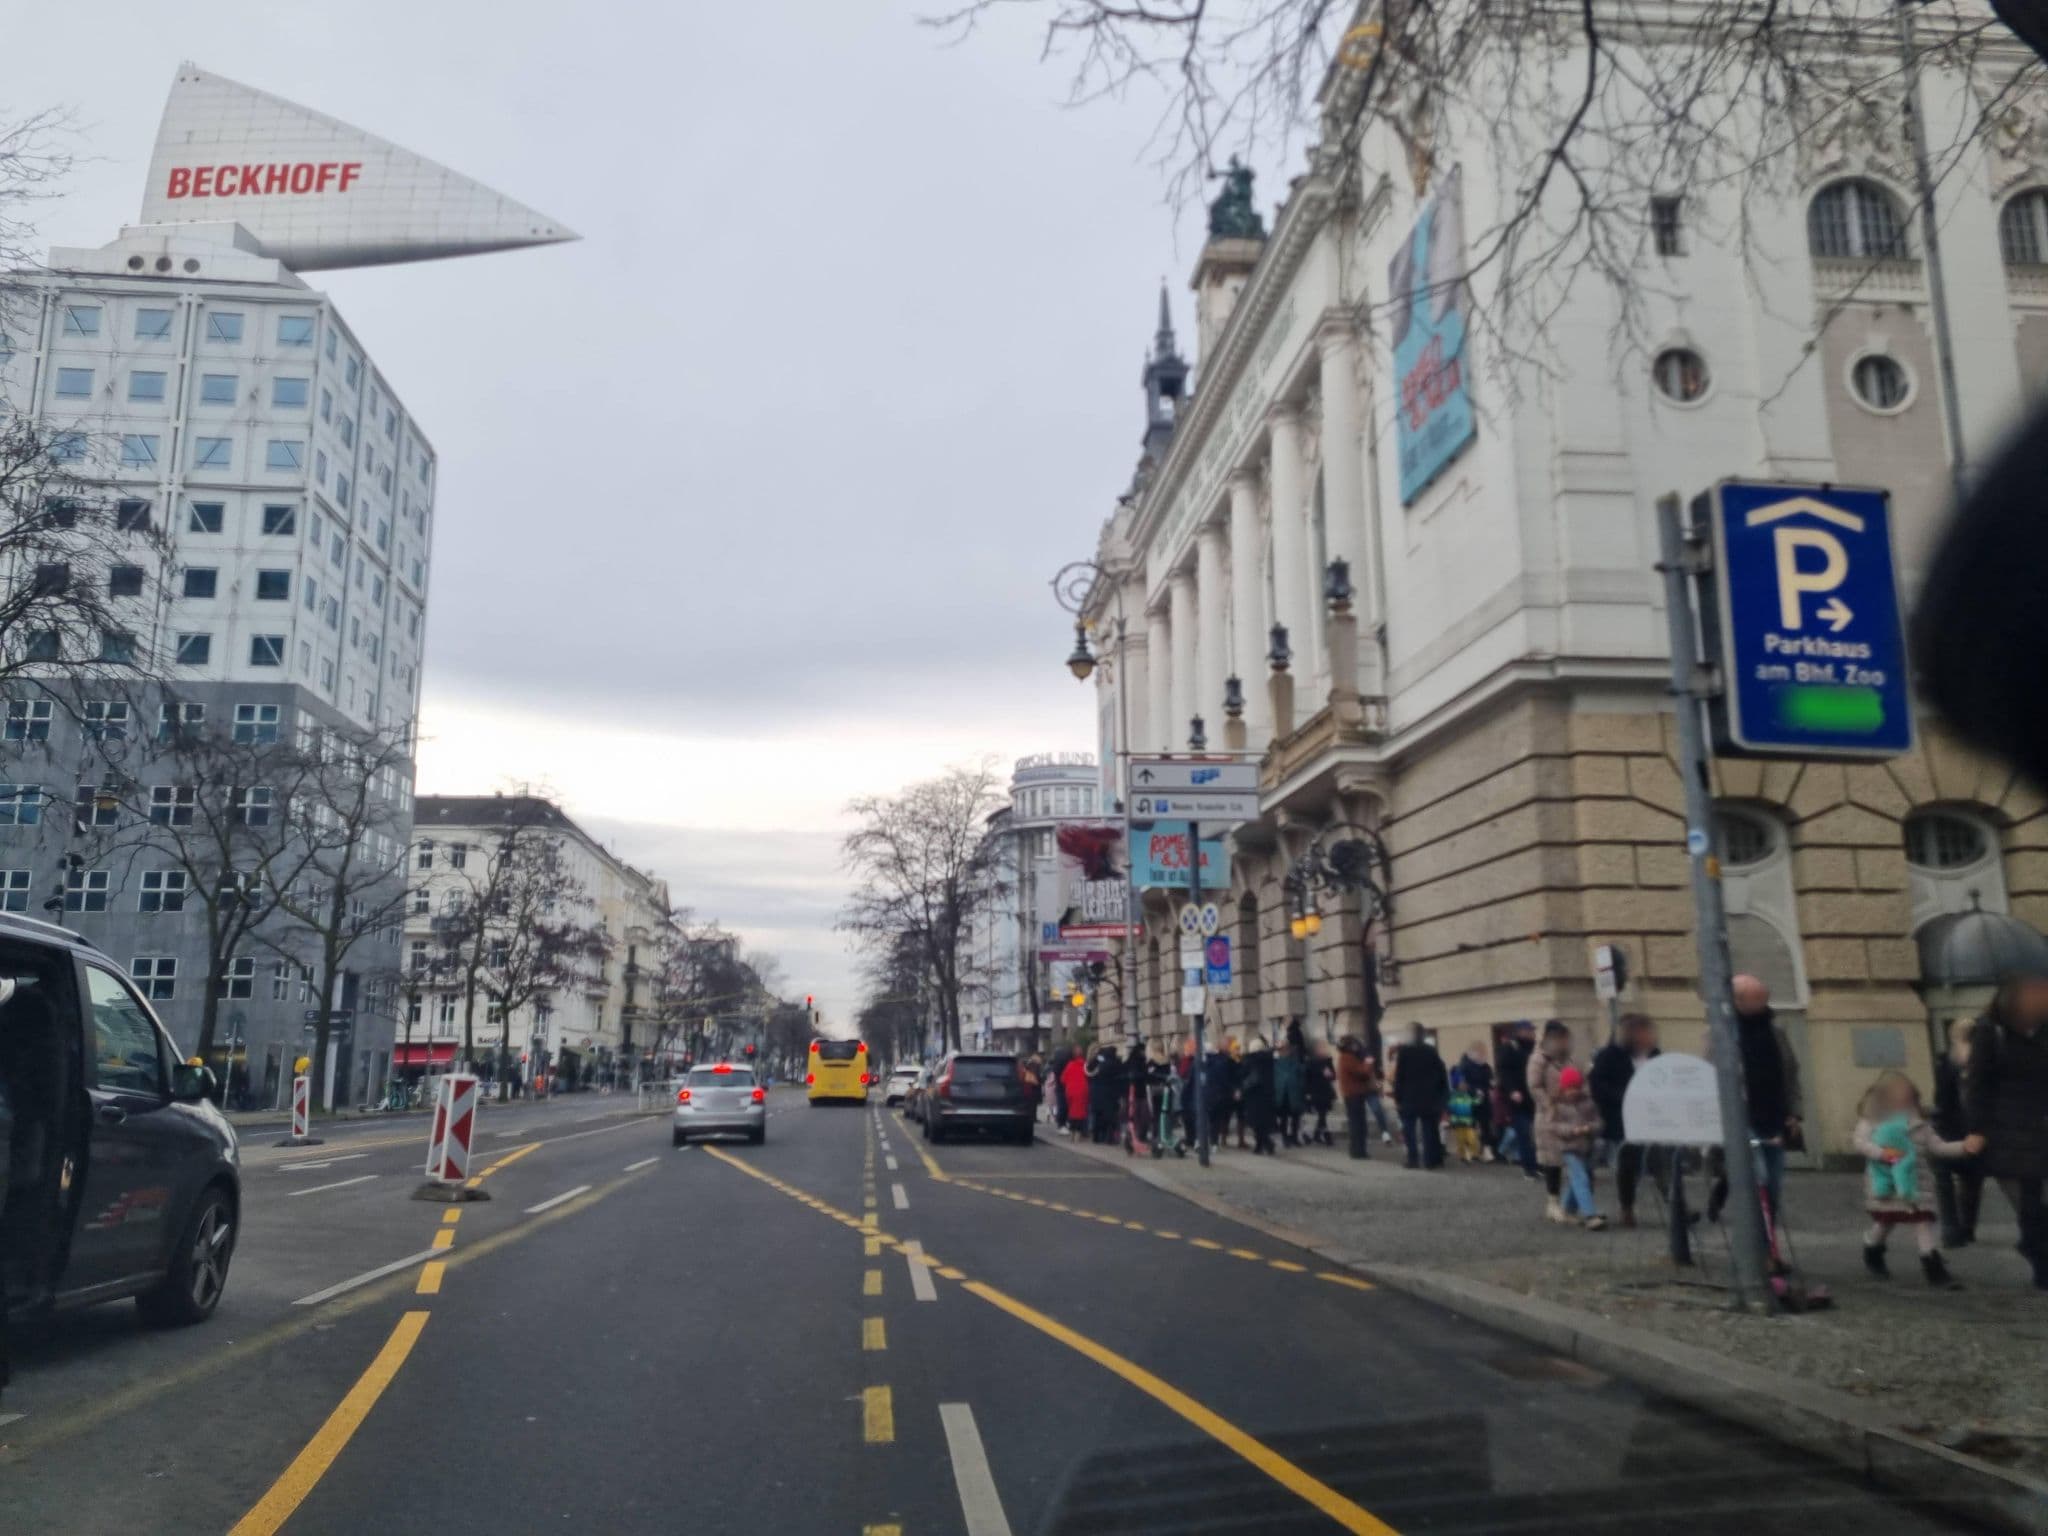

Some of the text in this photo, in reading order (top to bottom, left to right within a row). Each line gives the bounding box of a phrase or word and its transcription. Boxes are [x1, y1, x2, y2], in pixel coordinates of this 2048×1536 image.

[167, 162, 362, 199] BECKHOFF
[1772, 527, 1849, 630] P
[1764, 633, 1871, 658] Parkhaus
[1755, 662, 1886, 686] am Bhf. Zoo
